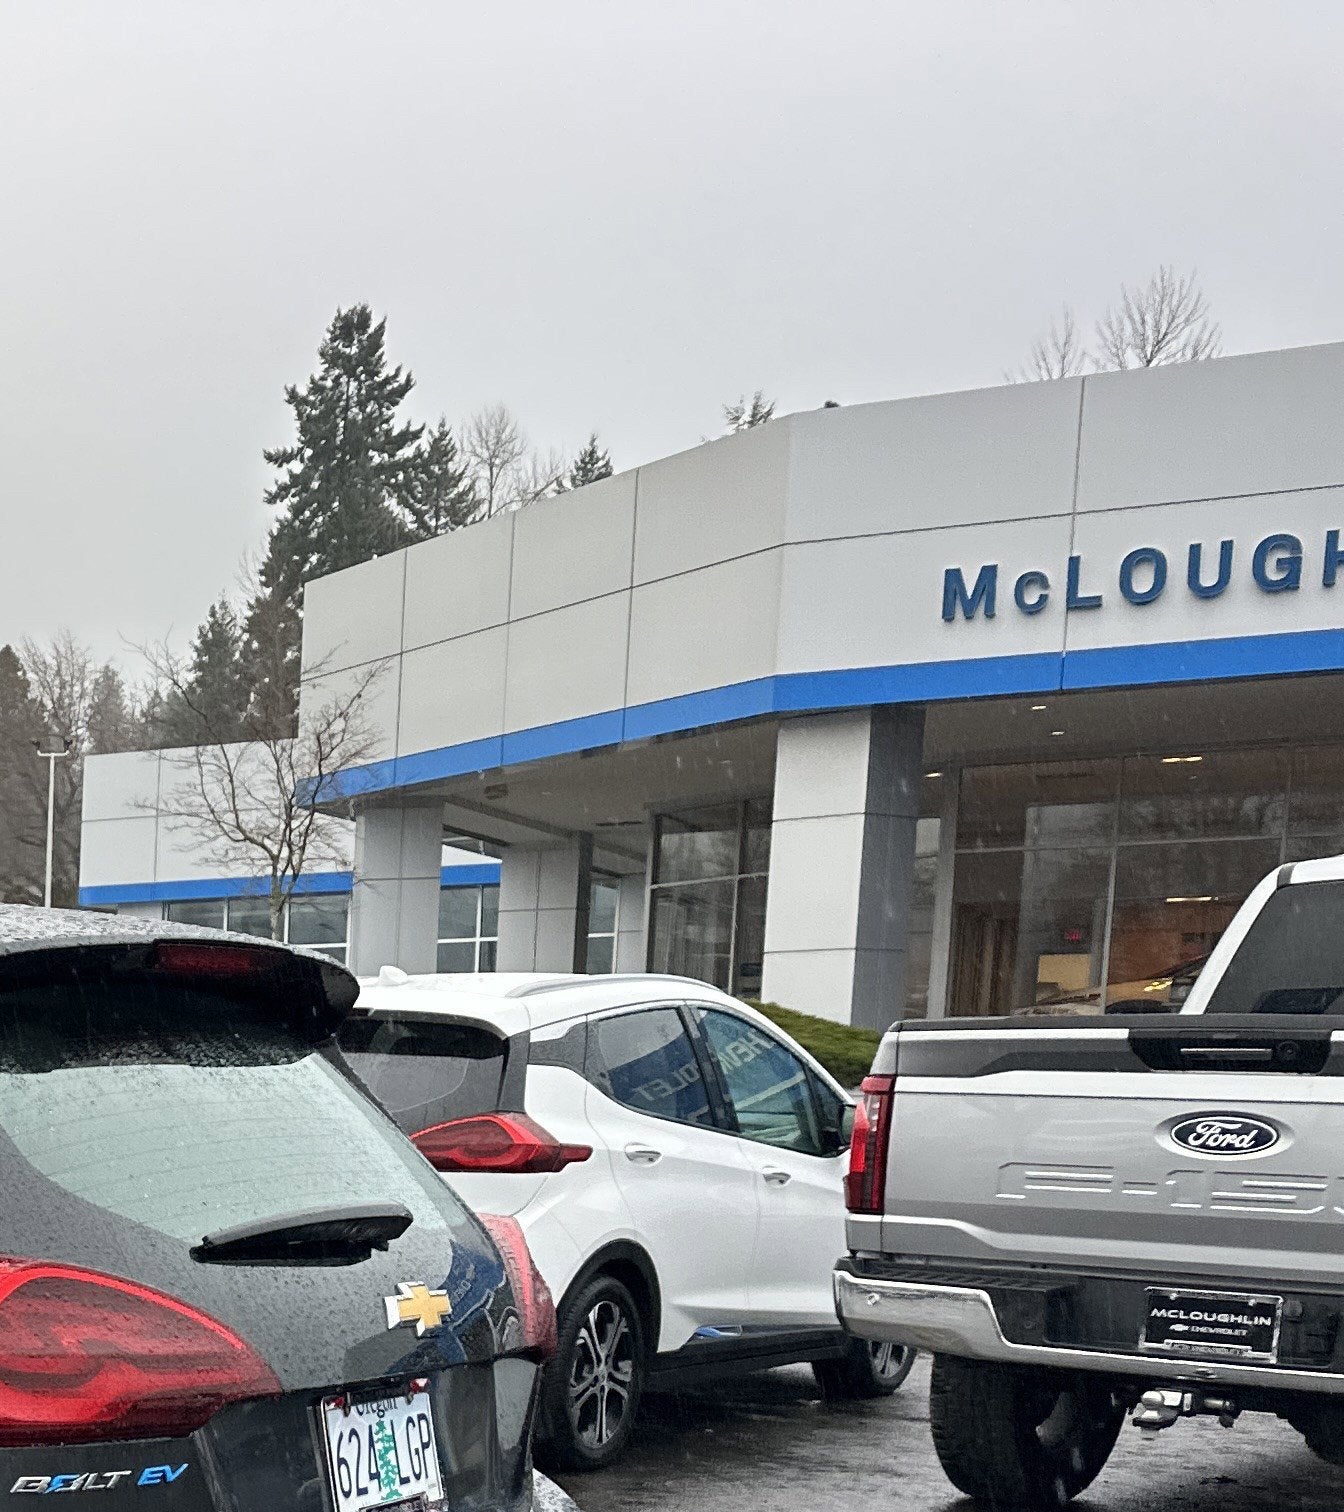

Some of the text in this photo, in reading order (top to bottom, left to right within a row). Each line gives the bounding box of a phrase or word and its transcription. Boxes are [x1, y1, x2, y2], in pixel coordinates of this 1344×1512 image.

[1188, 1120, 1258, 1149] Ford
[995, 1161, 1344, 1216] F-15
[1149, 1308, 1272, 1326] MCLOUGHLIN
[336, 1413, 432, 1499] 624 LGP
[10, 1463, 189, 1494] BOLT EV
